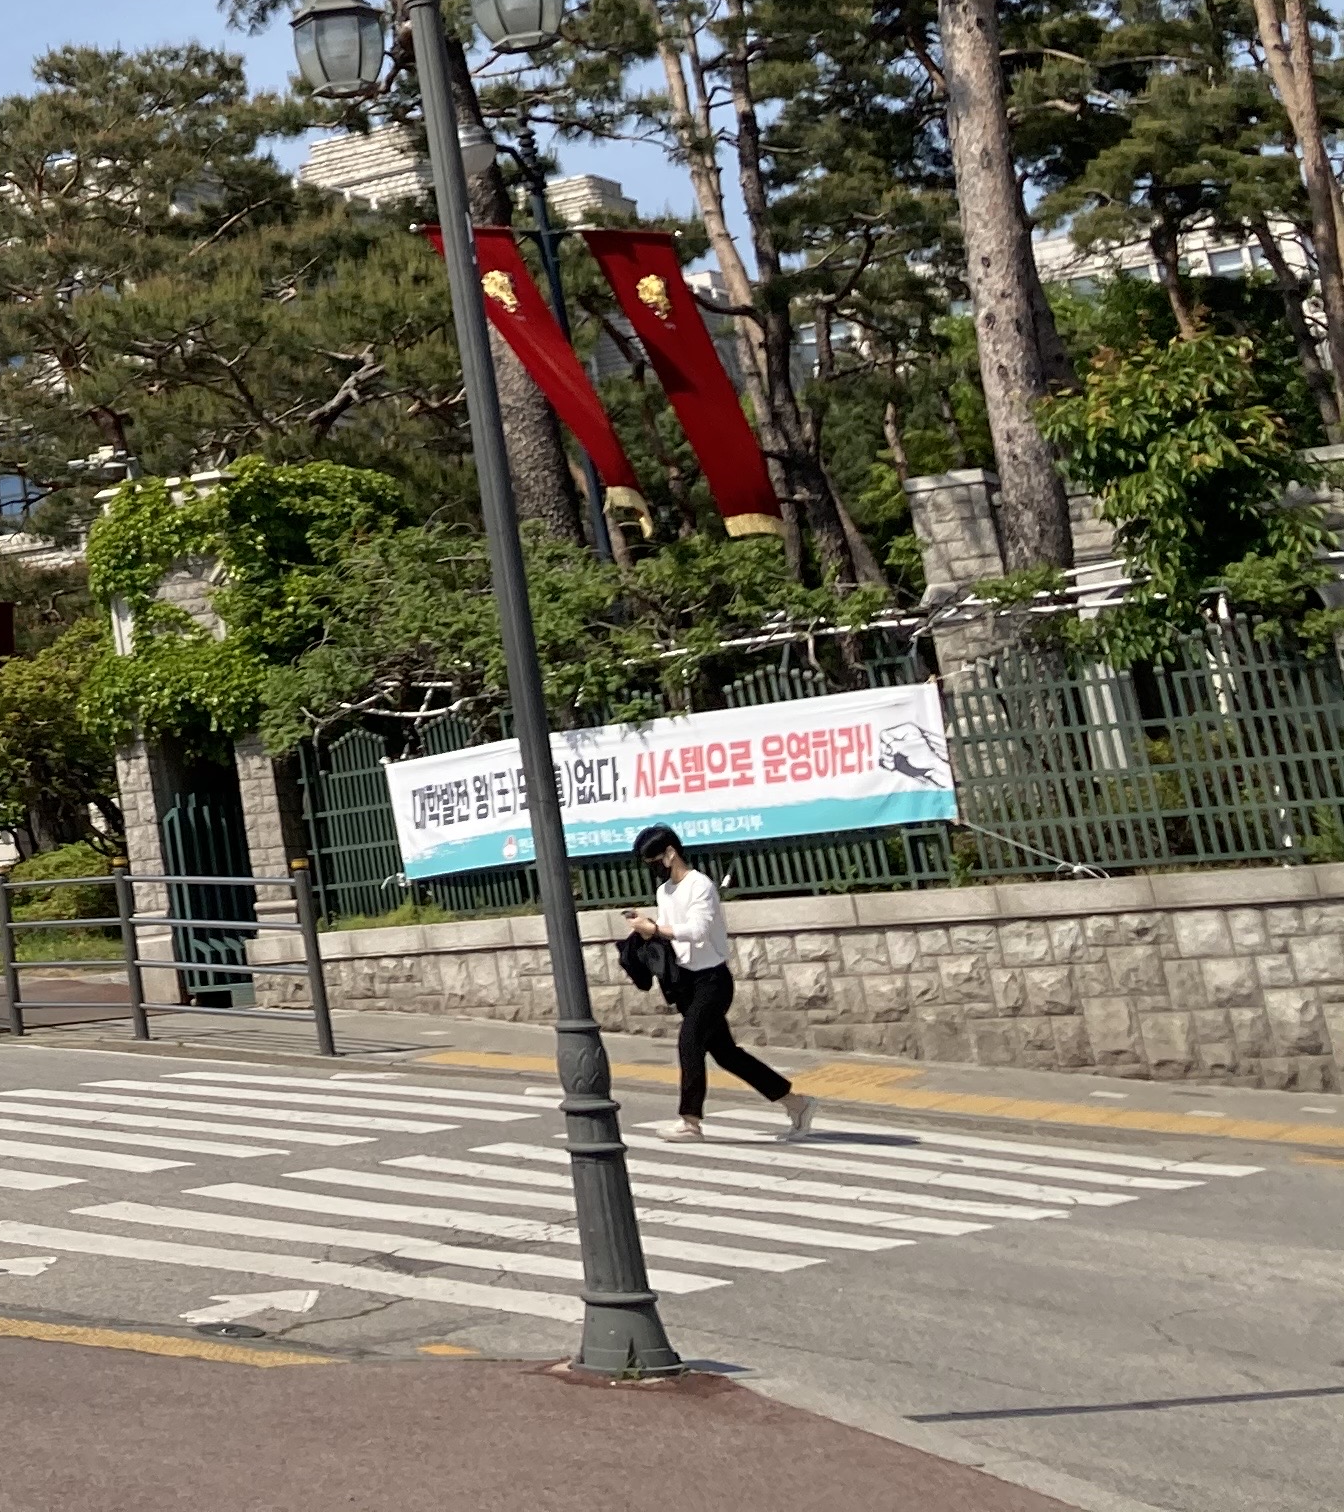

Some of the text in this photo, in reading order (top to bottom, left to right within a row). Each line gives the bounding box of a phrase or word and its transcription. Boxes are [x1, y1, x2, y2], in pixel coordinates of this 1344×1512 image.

[412, 778, 470, 830] 대학발전
[634, 739, 755, 798] 시스템으로
[761, 721, 874, 785] 운영하라!
